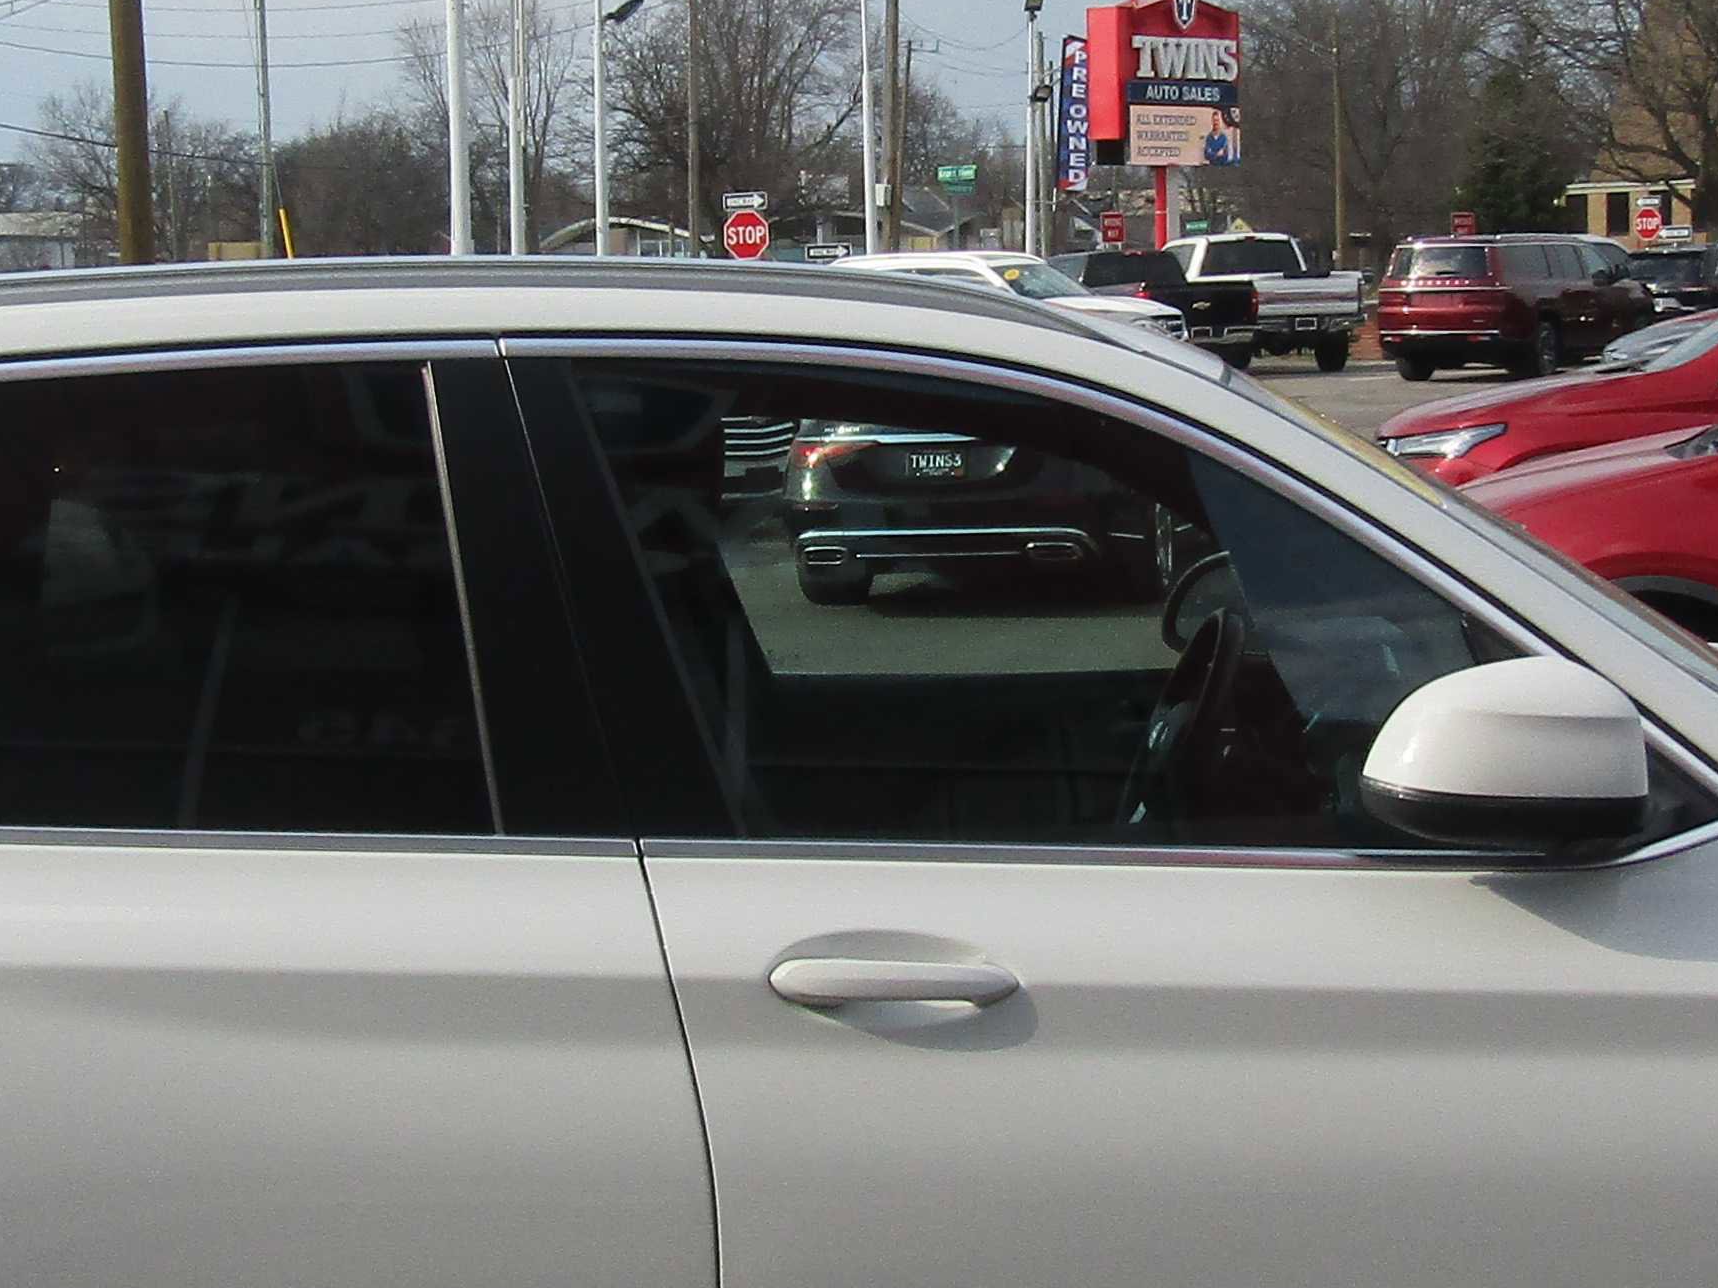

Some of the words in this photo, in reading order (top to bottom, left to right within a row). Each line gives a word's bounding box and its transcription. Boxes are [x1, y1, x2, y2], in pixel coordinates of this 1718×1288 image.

[1131, 35, 1238, 81] TWINS
[1071, 50, 1088, 98] PRE
[1145, 84, 1179, 100] AUTO
[1181, 87, 1221, 102] SALES
[1066, 104, 1089, 183] OWNED
[1636, 217, 1659, 230] STOP
[727, 226, 765, 245] STOP
[910, 453, 962, 468] TWINS3
